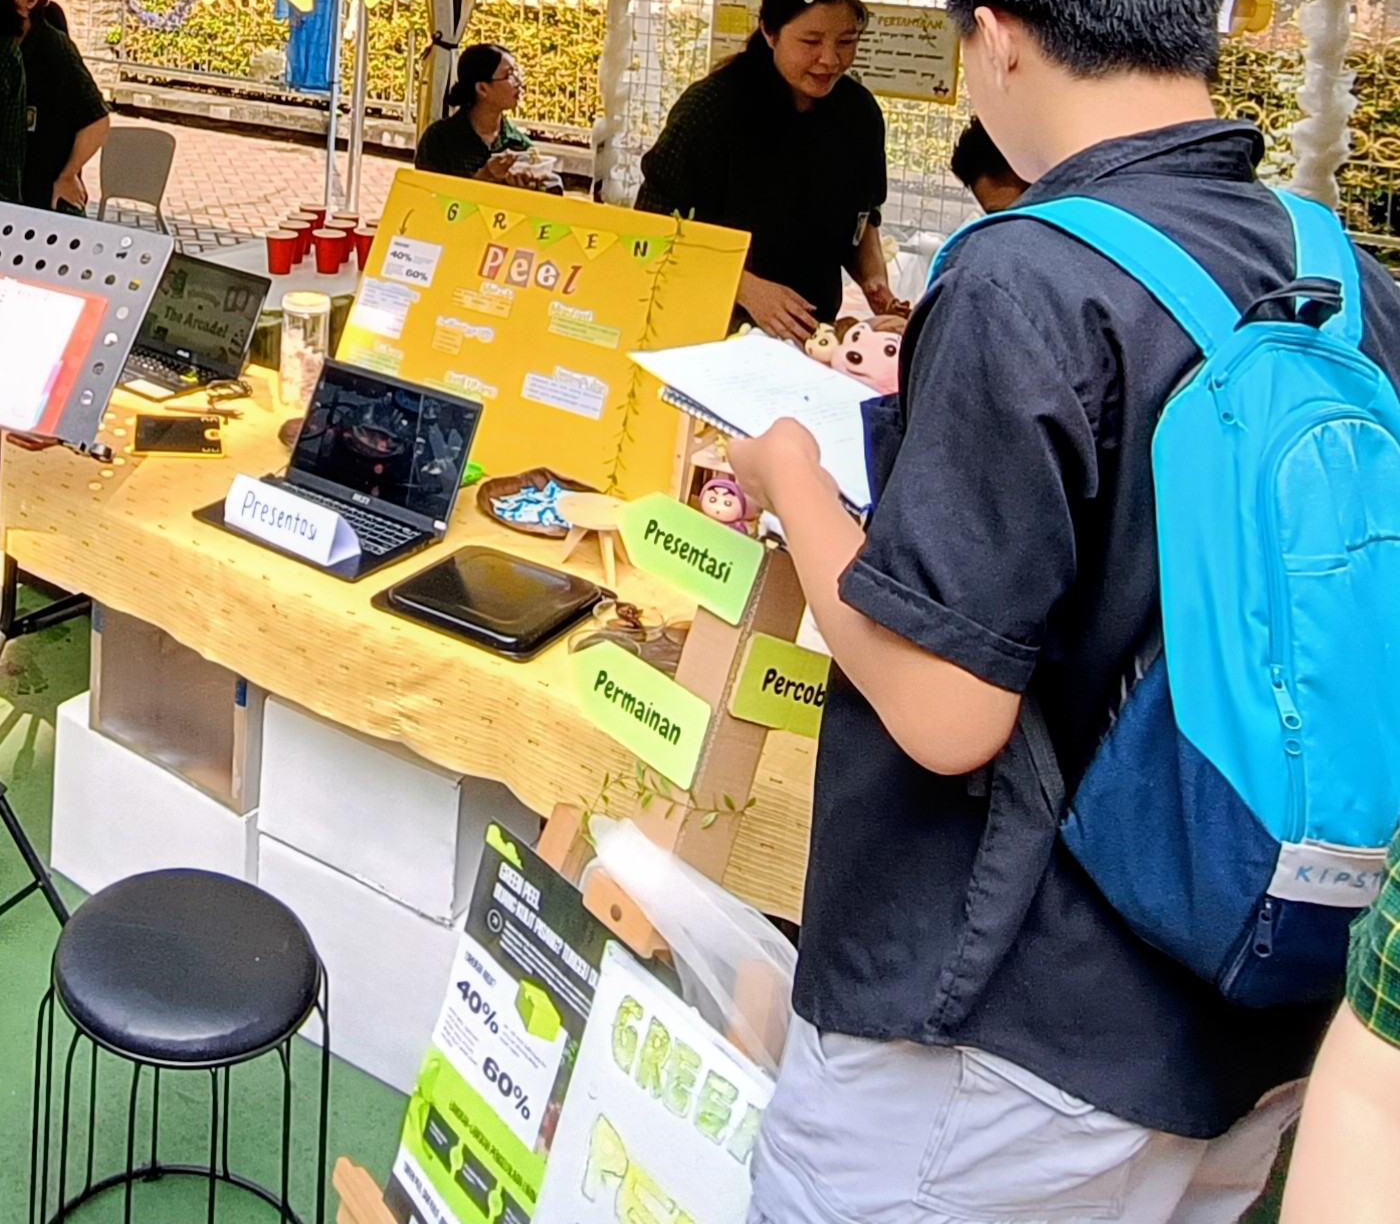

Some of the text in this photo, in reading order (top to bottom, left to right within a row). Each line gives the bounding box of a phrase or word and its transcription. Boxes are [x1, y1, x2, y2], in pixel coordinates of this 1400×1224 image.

[447, 202, 648, 258] GREEN
[481, 246, 583, 295] Peel
[643, 519, 733, 583] Presentasi
[593, 669, 681, 746] Permainan
[456, 980, 499, 1035] 40%
[482, 1056, 531, 1120] 60%
